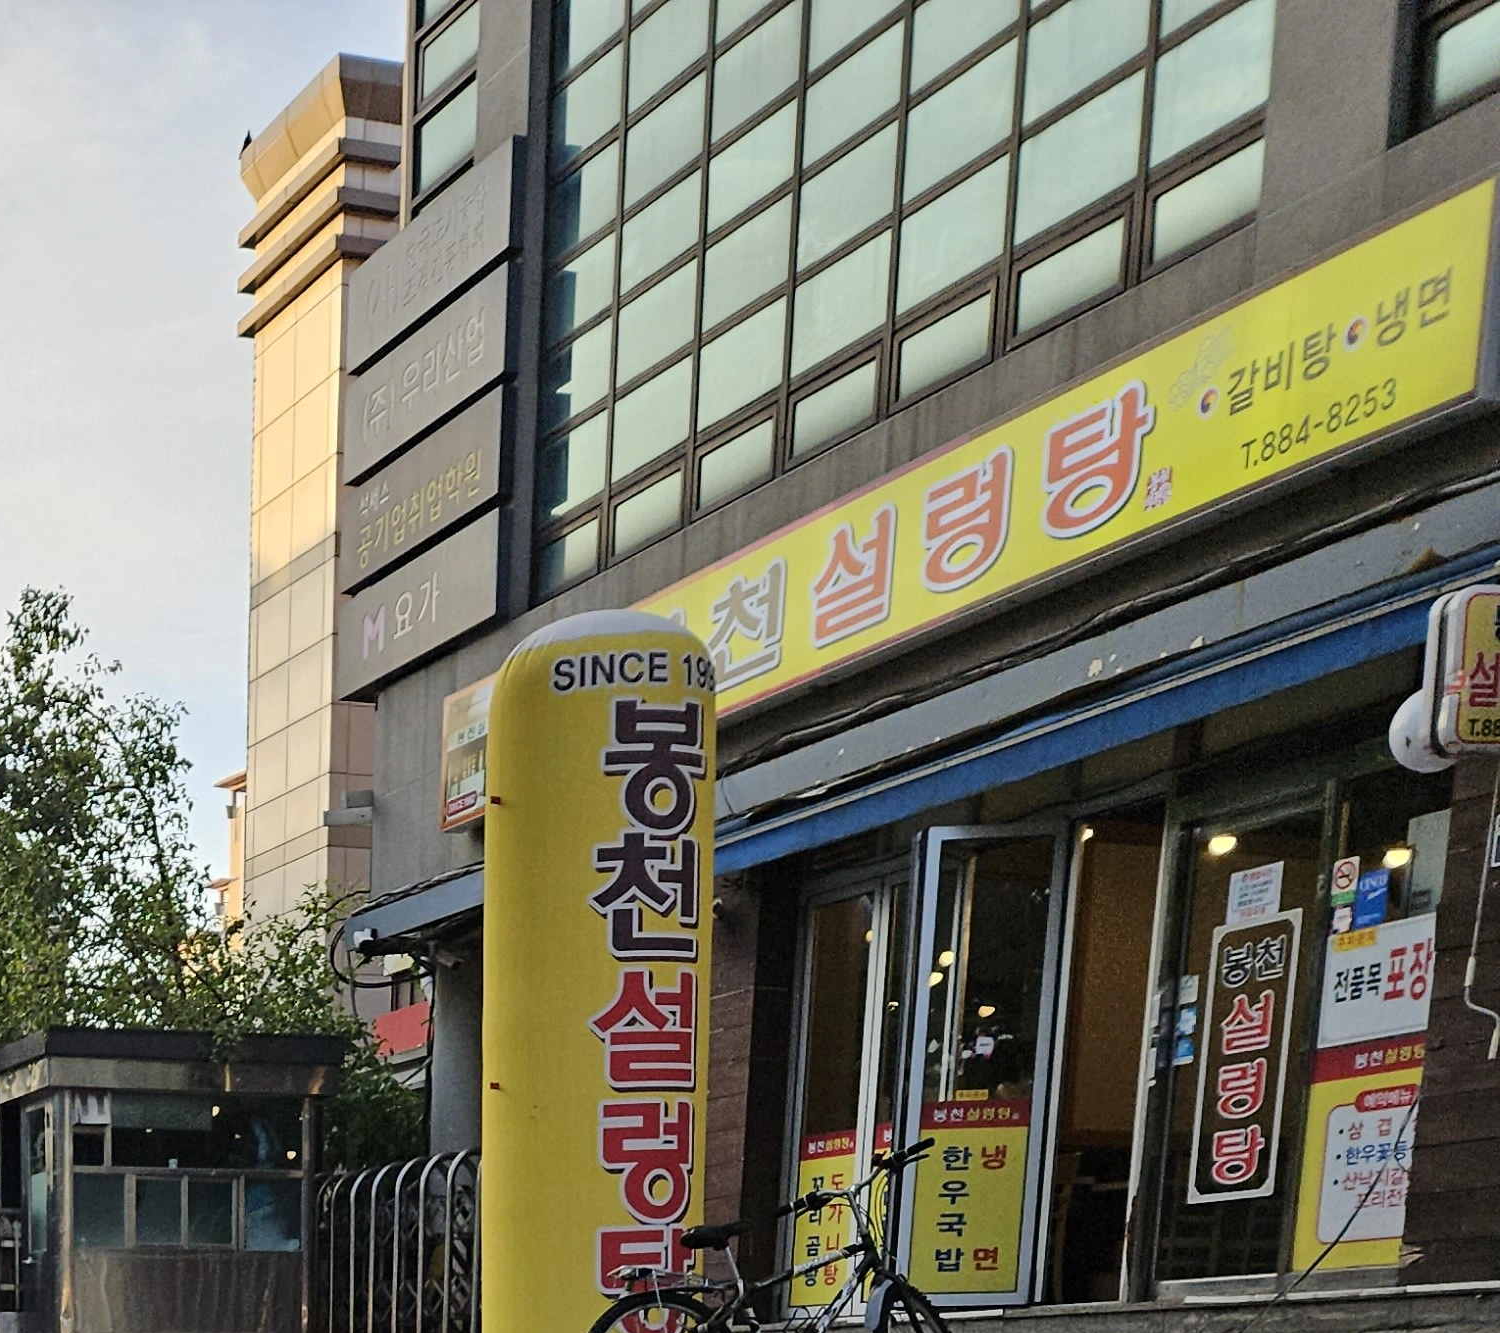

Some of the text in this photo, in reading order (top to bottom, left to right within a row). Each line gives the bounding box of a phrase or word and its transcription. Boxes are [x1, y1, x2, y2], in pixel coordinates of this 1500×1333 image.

[1226, 266, 1454, 416] 갈비탕 냉면
[1240, 377, 1398, 470] T.884-8253
[393, 571, 441, 640] 요가
[552, 650, 669, 692] SINCE
[1221, 934, 1288, 989] 봉천
[1383, 937, 1434, 1002] 포장
[1212, 989, 1275, 1185] 설렁탕
[935, 1146, 973, 1273] 한우국밥
